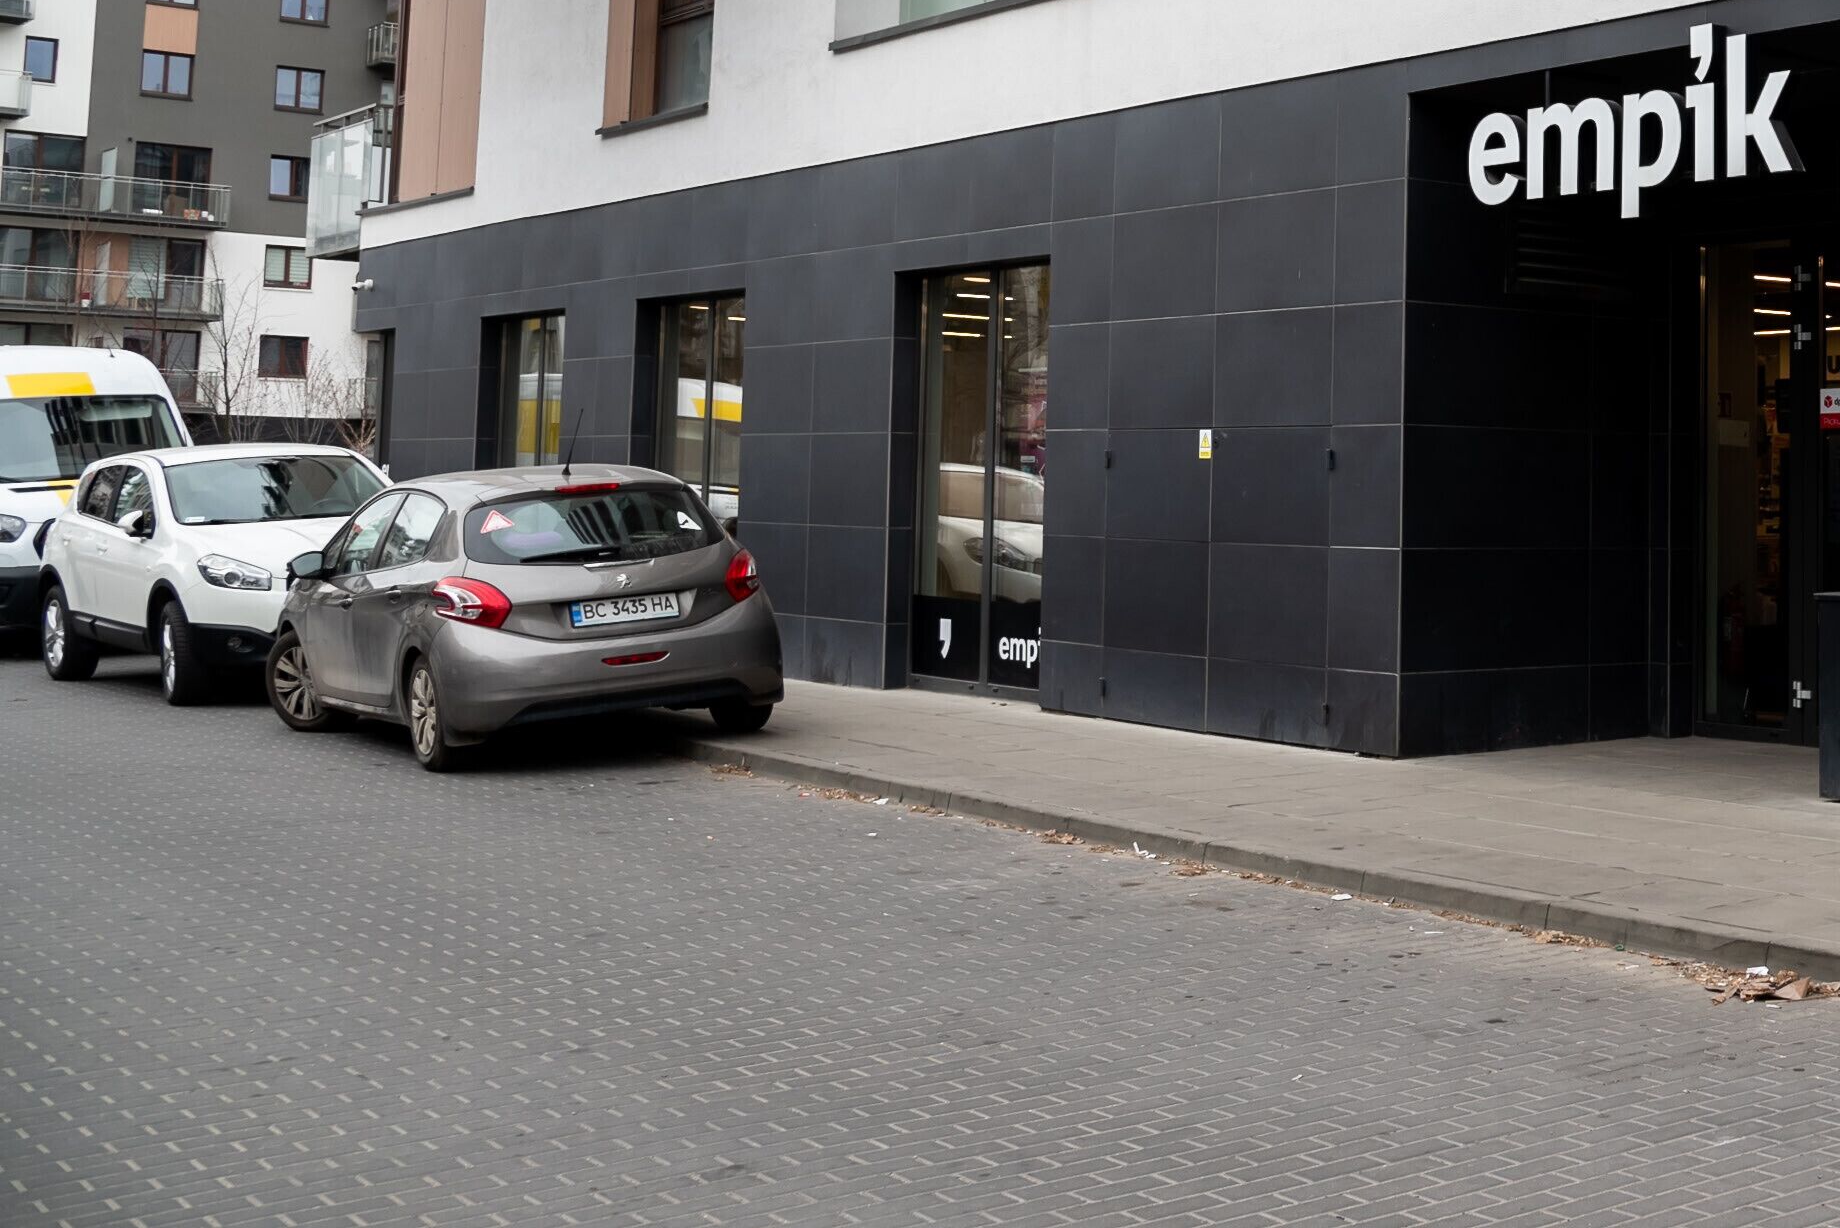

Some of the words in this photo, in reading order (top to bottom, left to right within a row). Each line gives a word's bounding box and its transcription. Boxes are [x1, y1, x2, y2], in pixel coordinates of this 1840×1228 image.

[1468, 22, 1794, 219] empik
[582, 602, 607, 620] BC
[610, 598, 648, 616] 3435
[650, 596, 675, 612] HA
